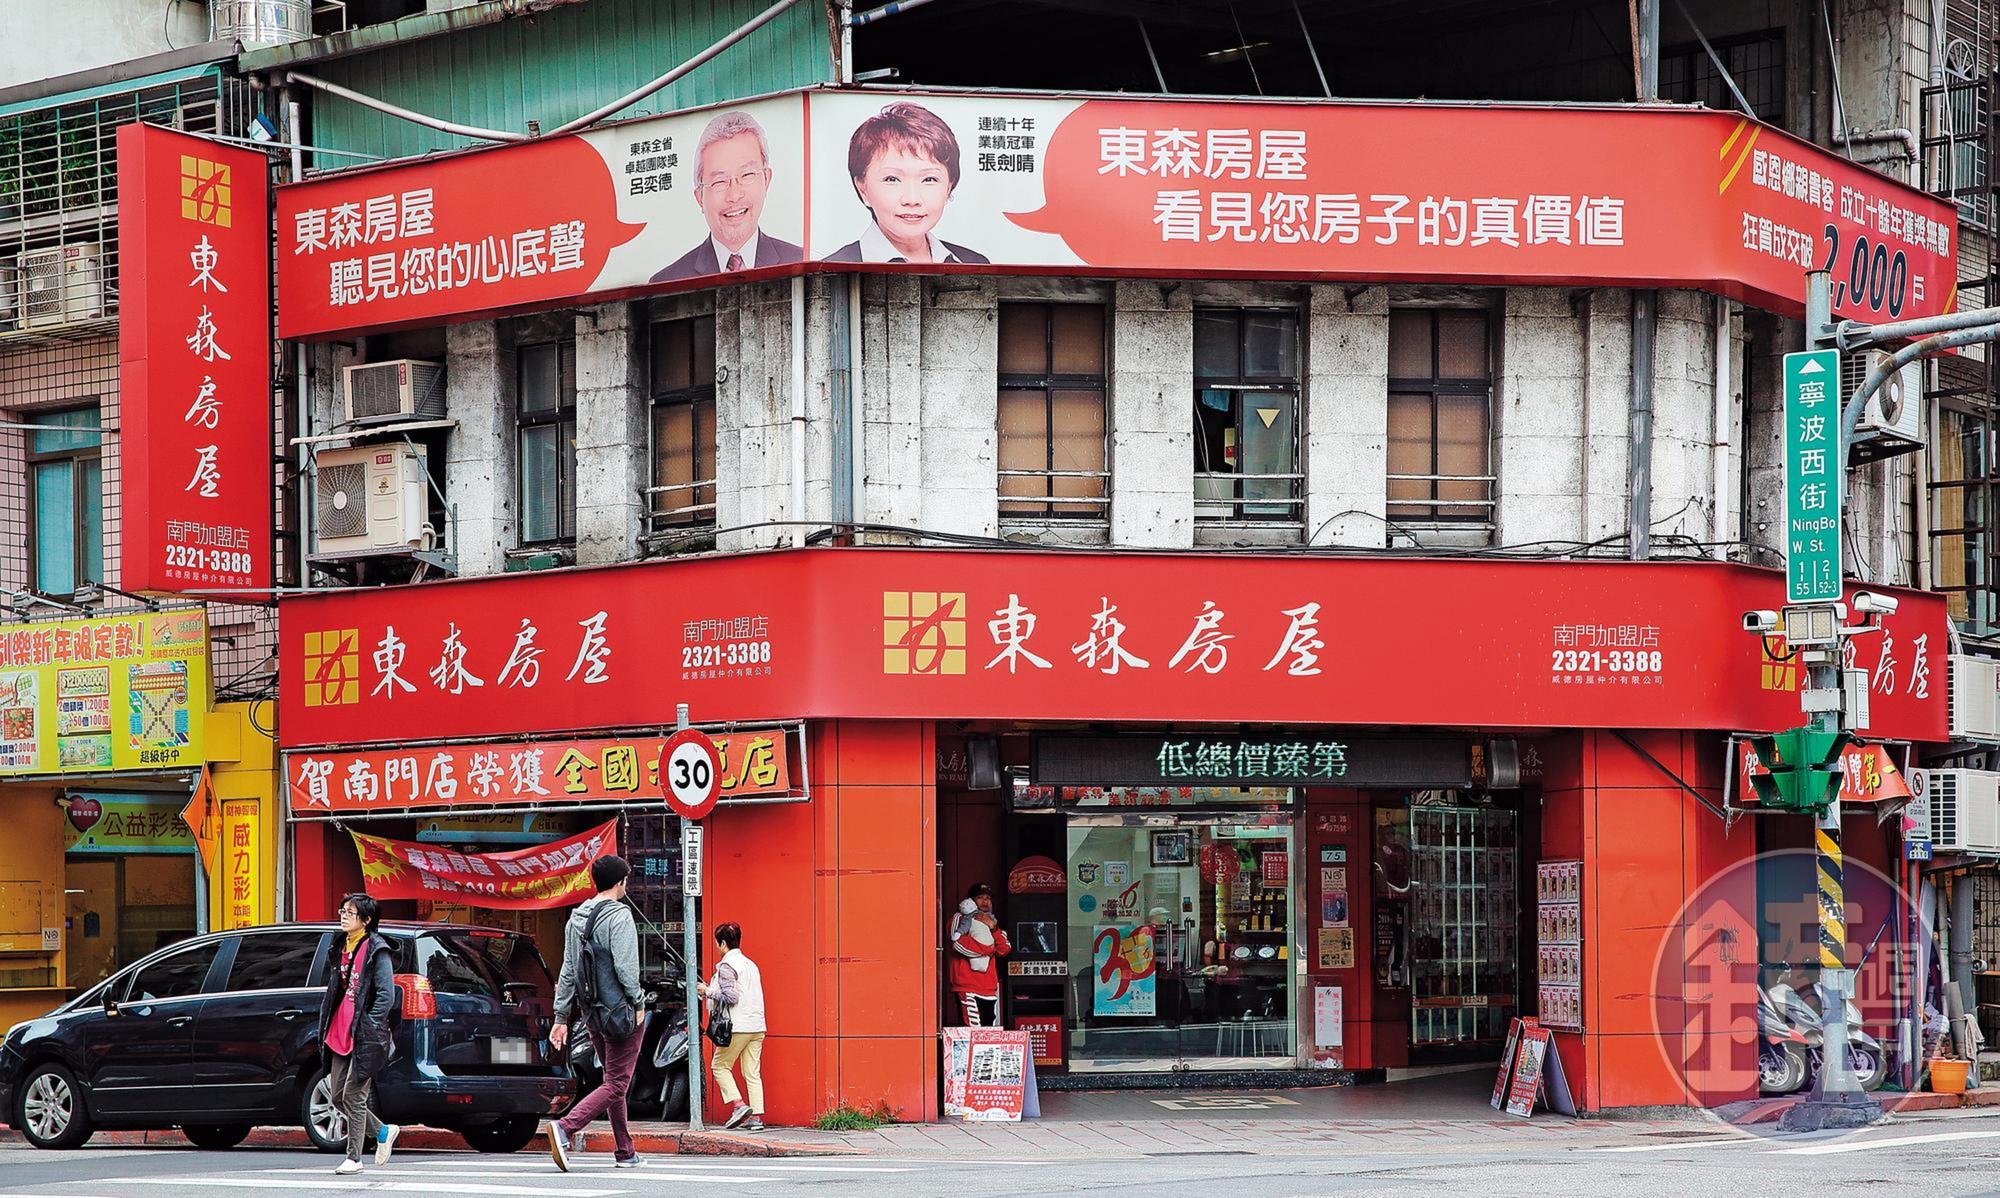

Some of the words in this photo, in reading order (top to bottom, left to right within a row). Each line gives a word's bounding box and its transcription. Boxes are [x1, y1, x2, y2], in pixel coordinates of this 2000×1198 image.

[978, 116, 1035, 131] 連續十年
[629, 137, 672, 156] 東森全省
[978, 135, 1035, 150] 業績冠軍
[1096, 126, 1307, 181] 東森房屋
[625, 154, 678, 175] 卓越團隊獎
[978, 153, 1034, 173] 張劍晴
[629, 173, 672, 197] 呂奕德
[1152, 189, 1625, 248] 看見您房子的真價值
[1753, 149, 1834, 213] 感恩鄉親貴客
[1840, 186, 1949, 258] 成立十餘年獲獎無數
[294, 188, 434, 255] 東森房屋
[329, 221, 585, 307] 聽見您的心底聲
[1742, 211, 1813, 269] 狂賀成交破
[1912, 274, 1925, 307] 戶
[185, 234, 231, 498] 東森房屋
[1798, 381, 1827, 511] 寧波西街
[166, 519, 250, 550] 南門加盟店
[1792, 517, 1836, 538] NingBo
[166, 544, 252, 574] 2321-3388
[1792, 541, 1806, 554] W.
[1810, 539, 1826, 552] St.
[683, 615, 768, 642] 南門加盟店
[984, 593, 1327, 677] 東森房屋
[1552, 624, 1660, 648] 南門加盟店
[371, 610, 611, 699] 東森房屋
[681, 641, 771, 667] 2321-3388
[1552, 650, 1662, 672] 2321-3388
[139, 749, 180, 764] 超級好中
[297, 736, 778, 807] 賀南門店榮獲全國店
[1156, 741, 1348, 779] 低總價臻第
[674, 758, 710, 789] 30
[103, 811, 188, 838] 公益彩券
[233, 823, 250, 900] 威力彩
[687, 831, 699, 891] 工區速限
[1326, 851, 1341, 861] 75
